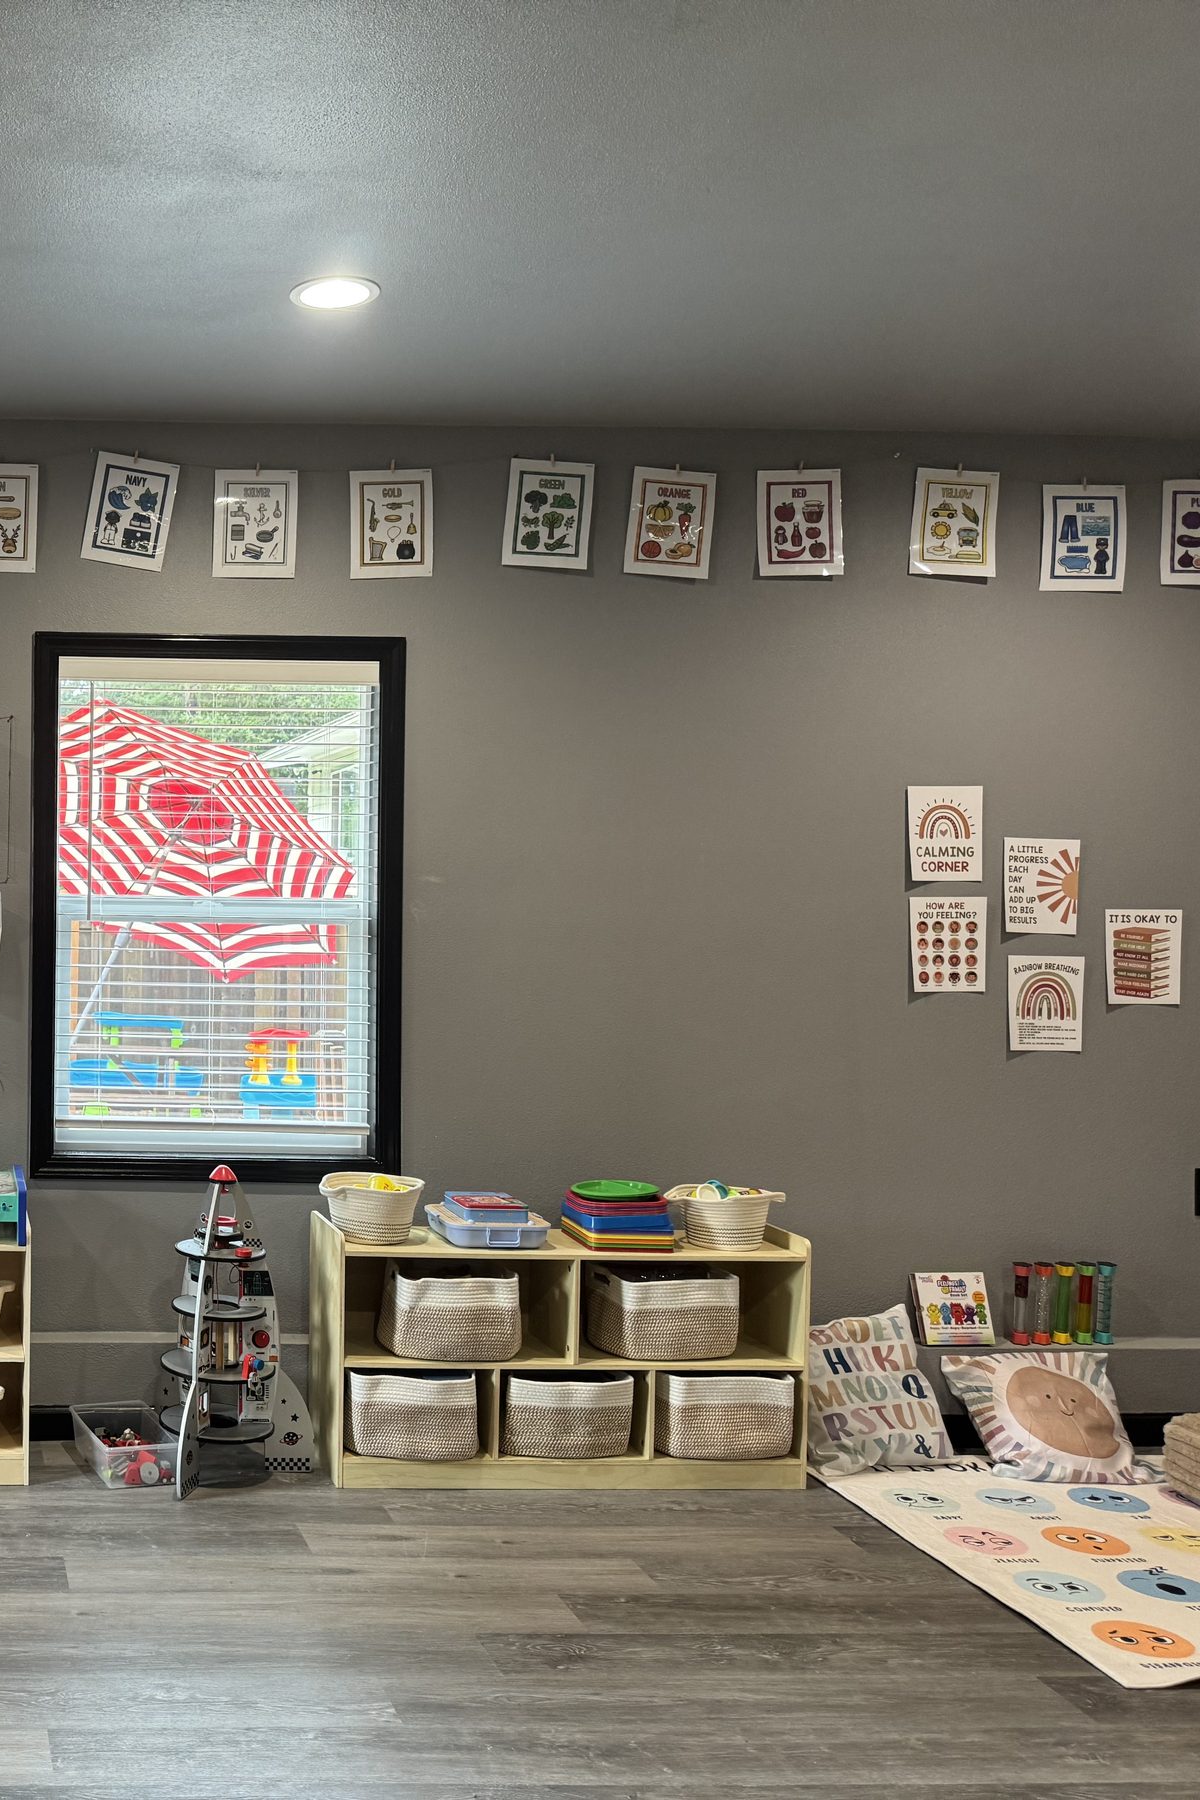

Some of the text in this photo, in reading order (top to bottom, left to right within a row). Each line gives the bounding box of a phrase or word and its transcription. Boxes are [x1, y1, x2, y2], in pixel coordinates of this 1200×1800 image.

[125, 475, 147, 488] NAVY
[538, 479, 566, 491] GREEN
[243, 487, 271, 499] SILVER
[382, 487, 402, 499] GOLD
[657, 487, 692, 500] ORANGE
[792, 488, 807, 499] RED
[941, 487, 974, 499] YELLOW
[1076, 502, 1095, 513] BLUE
[916, 846, 975, 857] CALMING
[1017, 845, 1043, 853] LITTLE
[1008, 855, 1049, 864] PROGRESS
[921, 861, 969, 872] CORNER
[1009, 896, 1036, 904] ADD UP
[925, 902, 965, 910] HOW ARE
[1009, 906, 1034, 914] TO BIG
[918, 911, 977, 919] YOU FEELING?
[1008, 916, 1037, 924] RESULTS
[1109, 915, 1177, 924] IT IS OKAY TO
[1013, 963, 1080, 976] RAINBOW BREATHING
